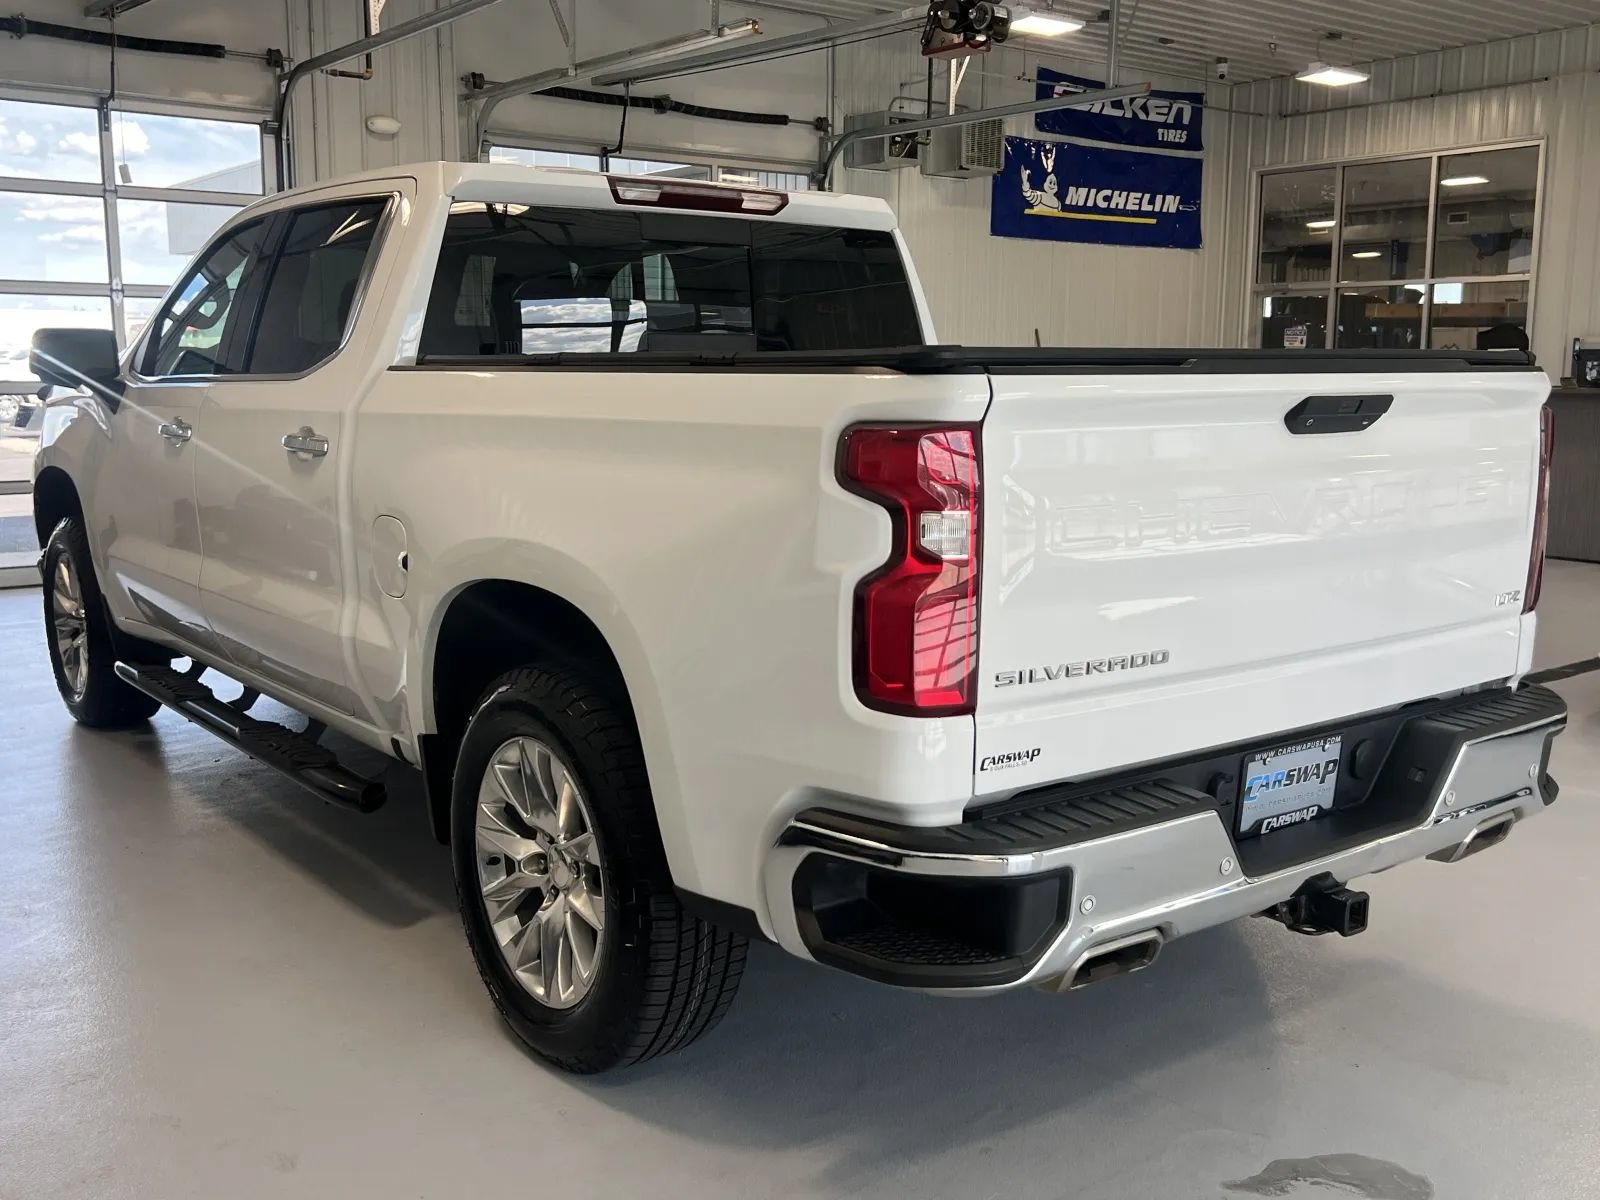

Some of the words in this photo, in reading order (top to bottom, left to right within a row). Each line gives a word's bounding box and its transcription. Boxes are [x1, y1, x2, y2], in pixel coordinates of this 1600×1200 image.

[1157, 128, 1187, 143] TIRES
[1065, 186, 1180, 213] MICHELIN
[1494, 590, 1521, 608] LTZ
[994, 649, 1170, 687] SILVERADO
[980, 747, 1041, 771] CARSWAP
[1244, 758, 1339, 803] CARSWAP
[1260, 805, 1319, 834] CARSWAP
